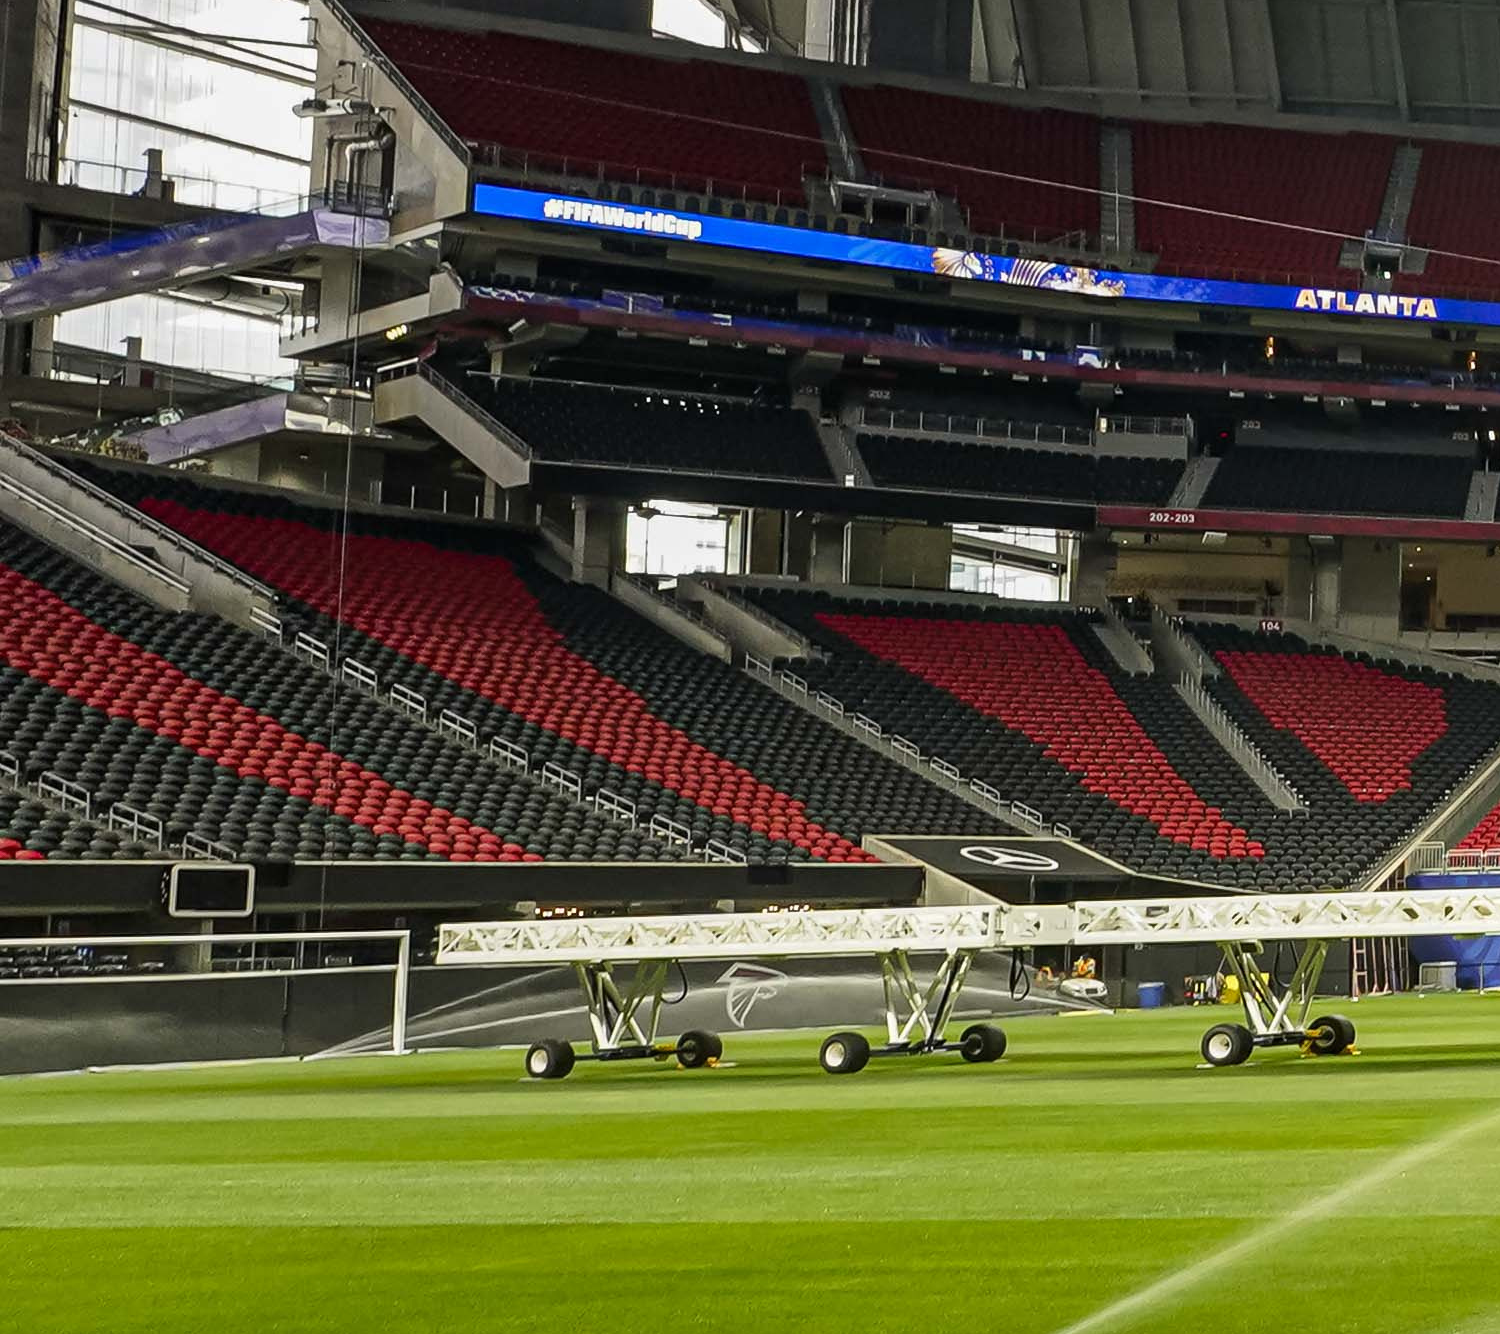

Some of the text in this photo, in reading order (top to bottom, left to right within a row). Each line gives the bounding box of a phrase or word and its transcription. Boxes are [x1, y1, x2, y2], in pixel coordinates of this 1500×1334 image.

[543, 198, 702, 240] #FIFAWorldCup
[1295, 288, 1439, 318] ATLANTA
[1241, 419, 1261, 430] 203
[1150, 513, 1195, 524] 202-203
[1262, 621, 1280, 631] 104
